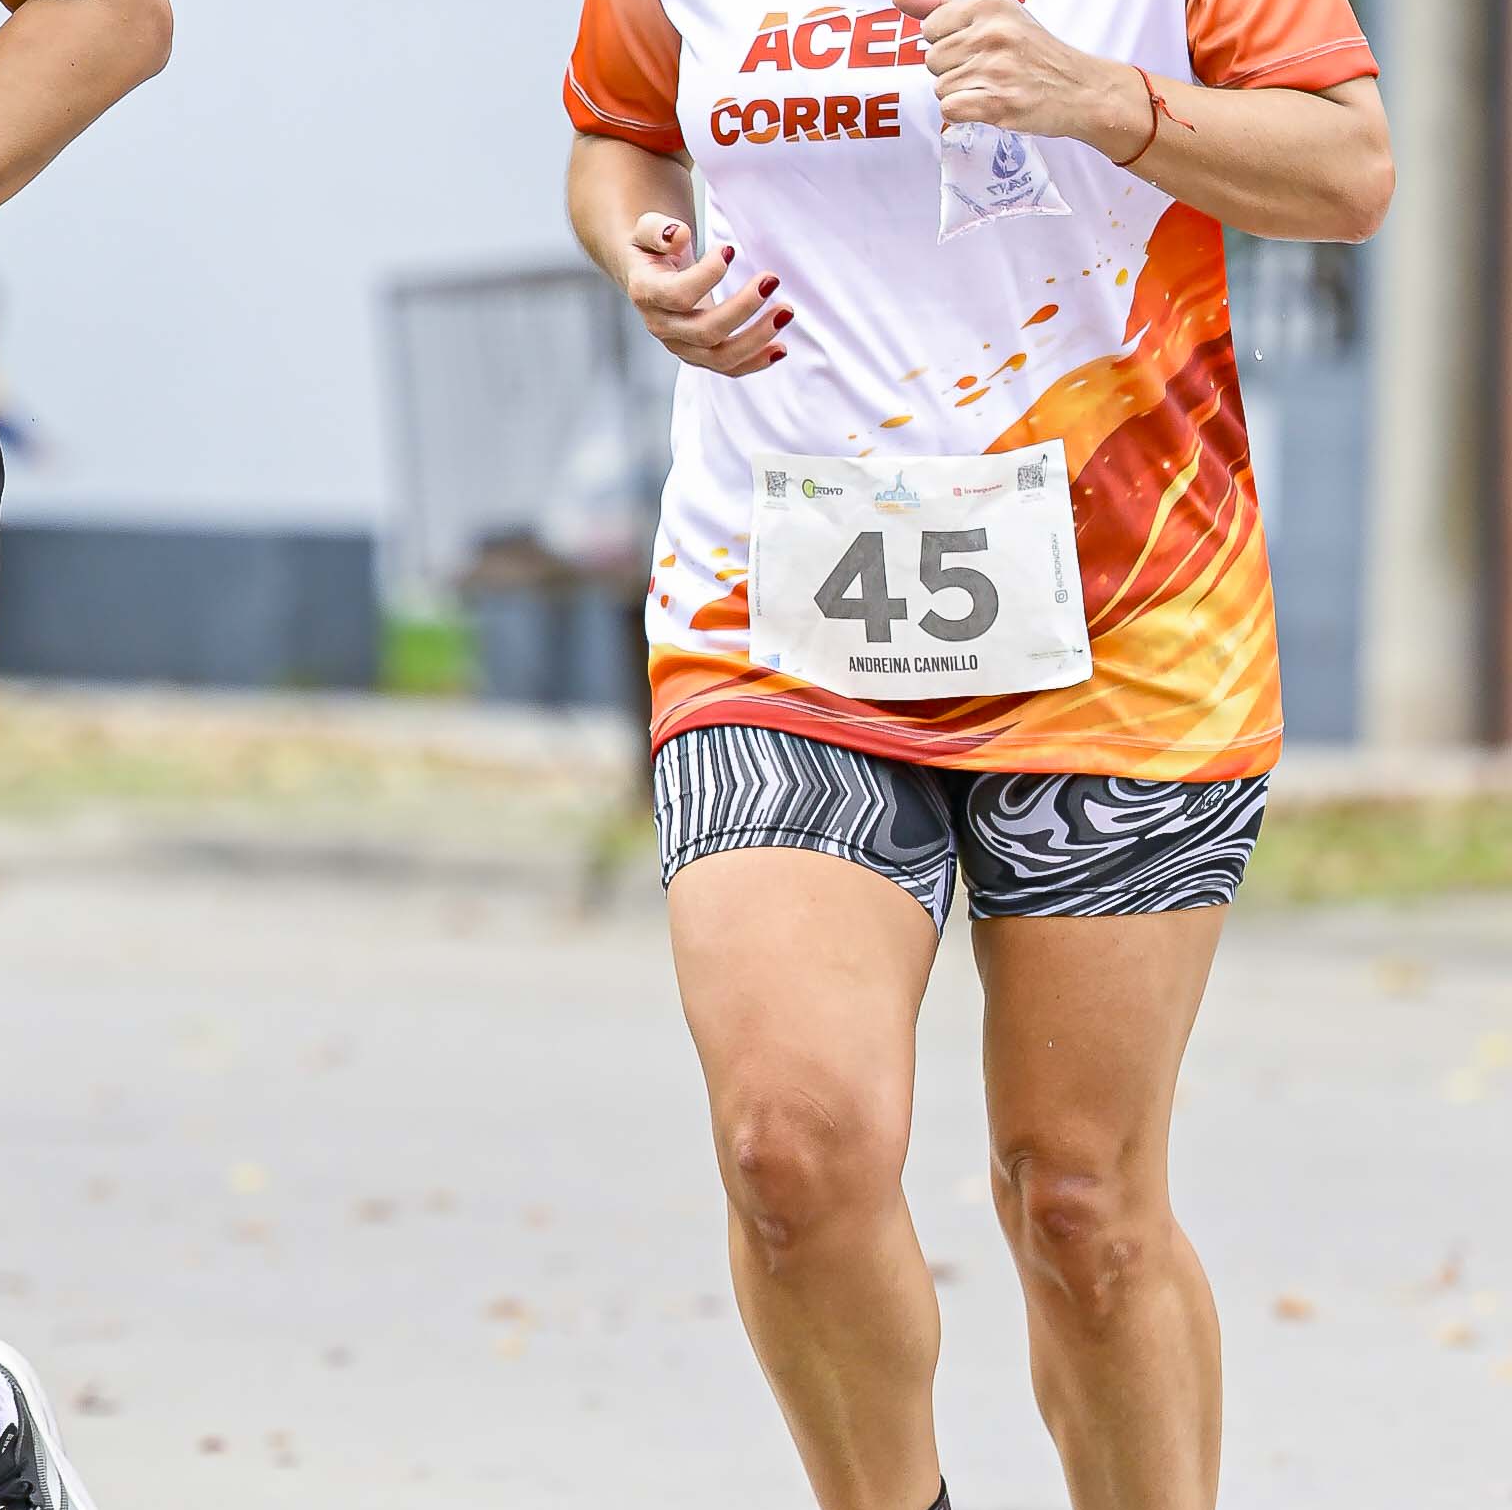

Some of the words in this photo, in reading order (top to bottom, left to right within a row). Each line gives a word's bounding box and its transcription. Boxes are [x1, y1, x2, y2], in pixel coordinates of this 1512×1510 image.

[710, 92, 900, 146] CORRE
[813, 527, 999, 643] 45
[848, 656, 912, 674] ANDREINA
[913, 654, 978, 672] CANNILLO
